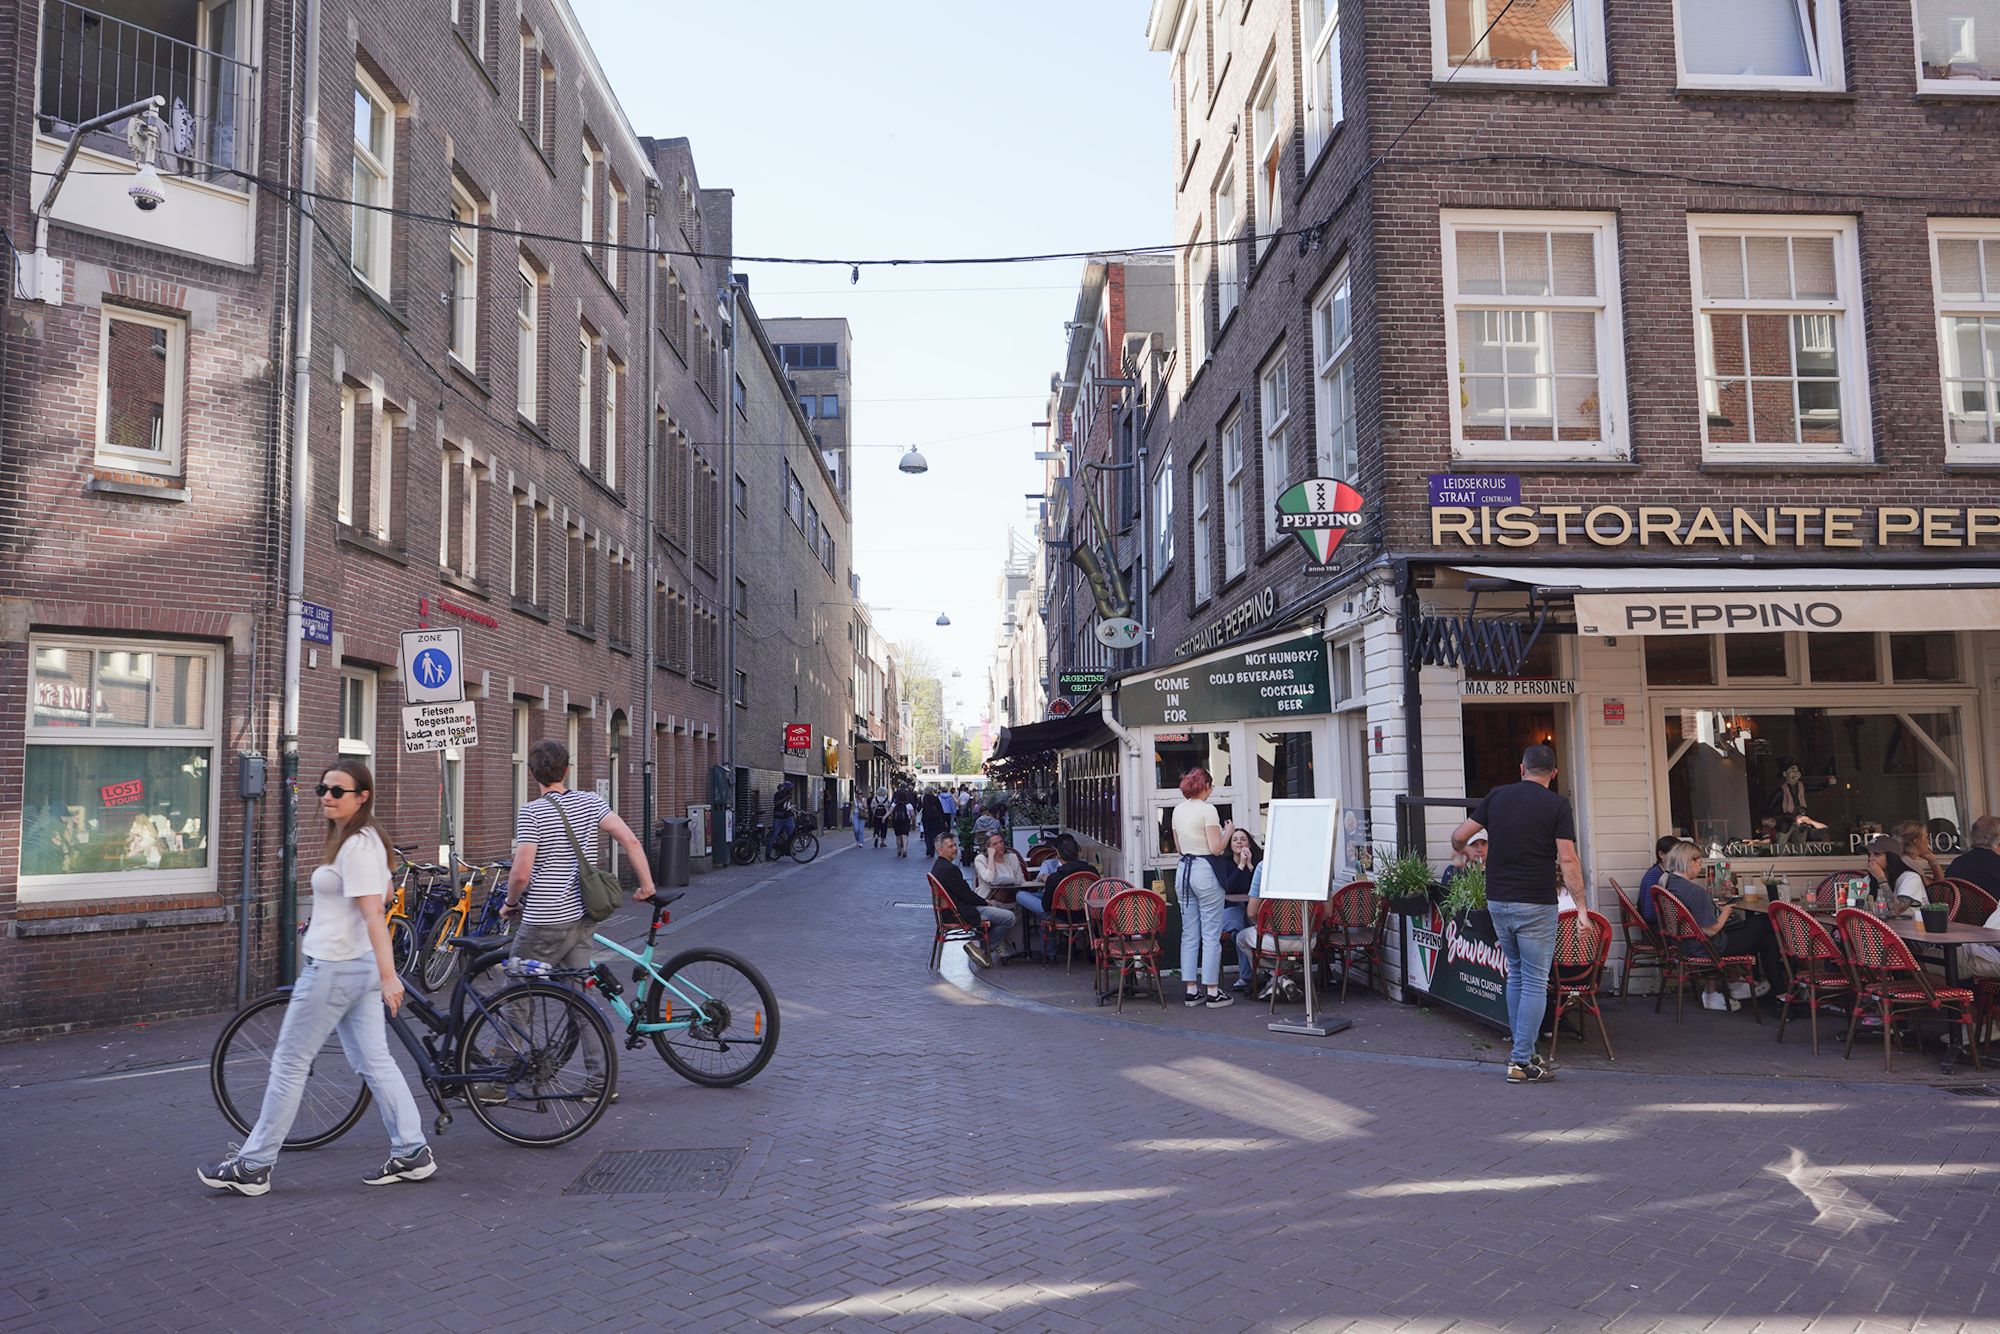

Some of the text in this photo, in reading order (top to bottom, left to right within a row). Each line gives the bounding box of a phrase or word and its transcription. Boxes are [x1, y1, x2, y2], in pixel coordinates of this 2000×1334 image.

[1443, 478, 1506, 489] LEIDSEKRUIS
[1439, 492, 1476, 503] STRAAT
[1282, 513, 1362, 528] PEPPINO
[1431, 505, 2000, 547] RISTORANTE PEP
[302, 604, 314, 617] ORTE
[1225, 586, 1274, 641] PEPPINO
[1625, 602, 1842, 630] PEPPINO
[418, 634, 442, 642] ZONE
[1245, 650, 1319, 666] NOT HUNGRY?
[1060, 675, 1105, 683] ARGENTINE
[1154, 677, 1190, 691] COME
[1209, 669, 1295, 685] COLD BEVERAGES
[1260, 684, 1315, 697] COCKTAILS
[1465, 681, 1575, 695] MAX. 82 PERSONEN
[1166, 693, 1180, 707] IN
[1277, 699, 1303, 711] BEER
[422, 707, 455, 717] Fietsen
[1164, 709, 1188, 723] FOR
[414, 715, 465, 727] Toegestaan
[434, 729, 446, 737] en
[447, 726, 476, 736] lossen
[407, 743, 424, 751] Van
[432, 740, 447, 748] ot
[449, 737, 460, 746] 12
[462, 736, 477, 745] uur
[105, 782, 139, 798] LOST
[1769, 841, 1832, 855] ITALIANO
[1413, 929, 1441, 949] PEPPINO
[1459, 971, 1503, 995] ITALIAN CUISINE
